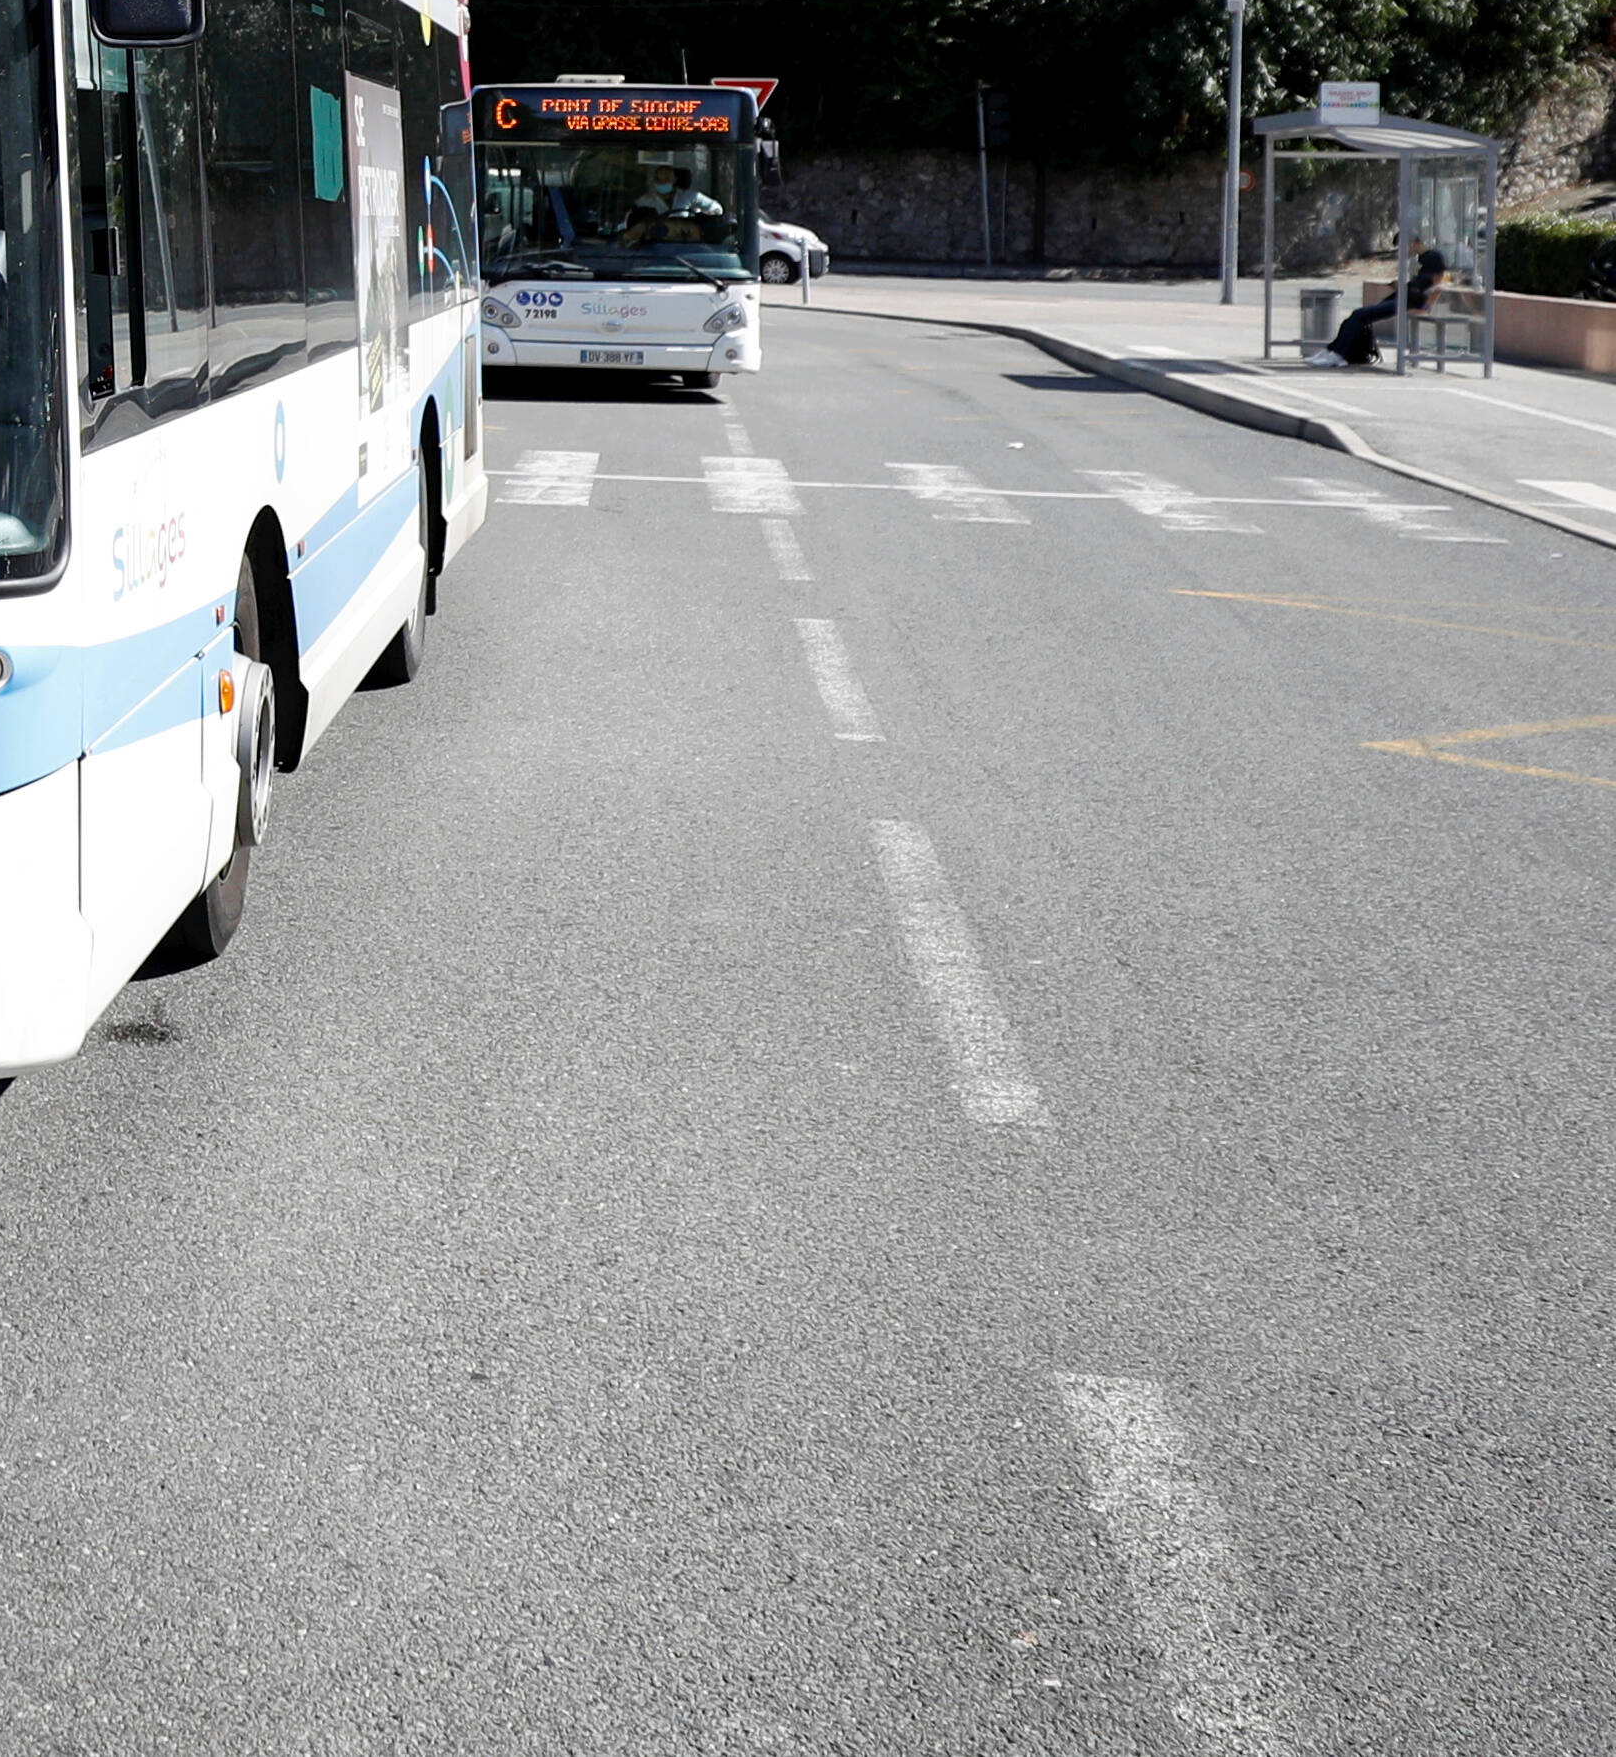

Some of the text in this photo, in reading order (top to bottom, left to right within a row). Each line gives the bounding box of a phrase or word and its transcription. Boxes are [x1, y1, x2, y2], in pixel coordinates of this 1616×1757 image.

[495, 98, 518, 129] C
[541, 99, 592, 113] PONT
[566, 116, 590, 131] VIA
[592, 116, 642, 132] GRASSE
[580, 302, 648, 319] Sillages
[112, 511, 186, 603] Sillages
